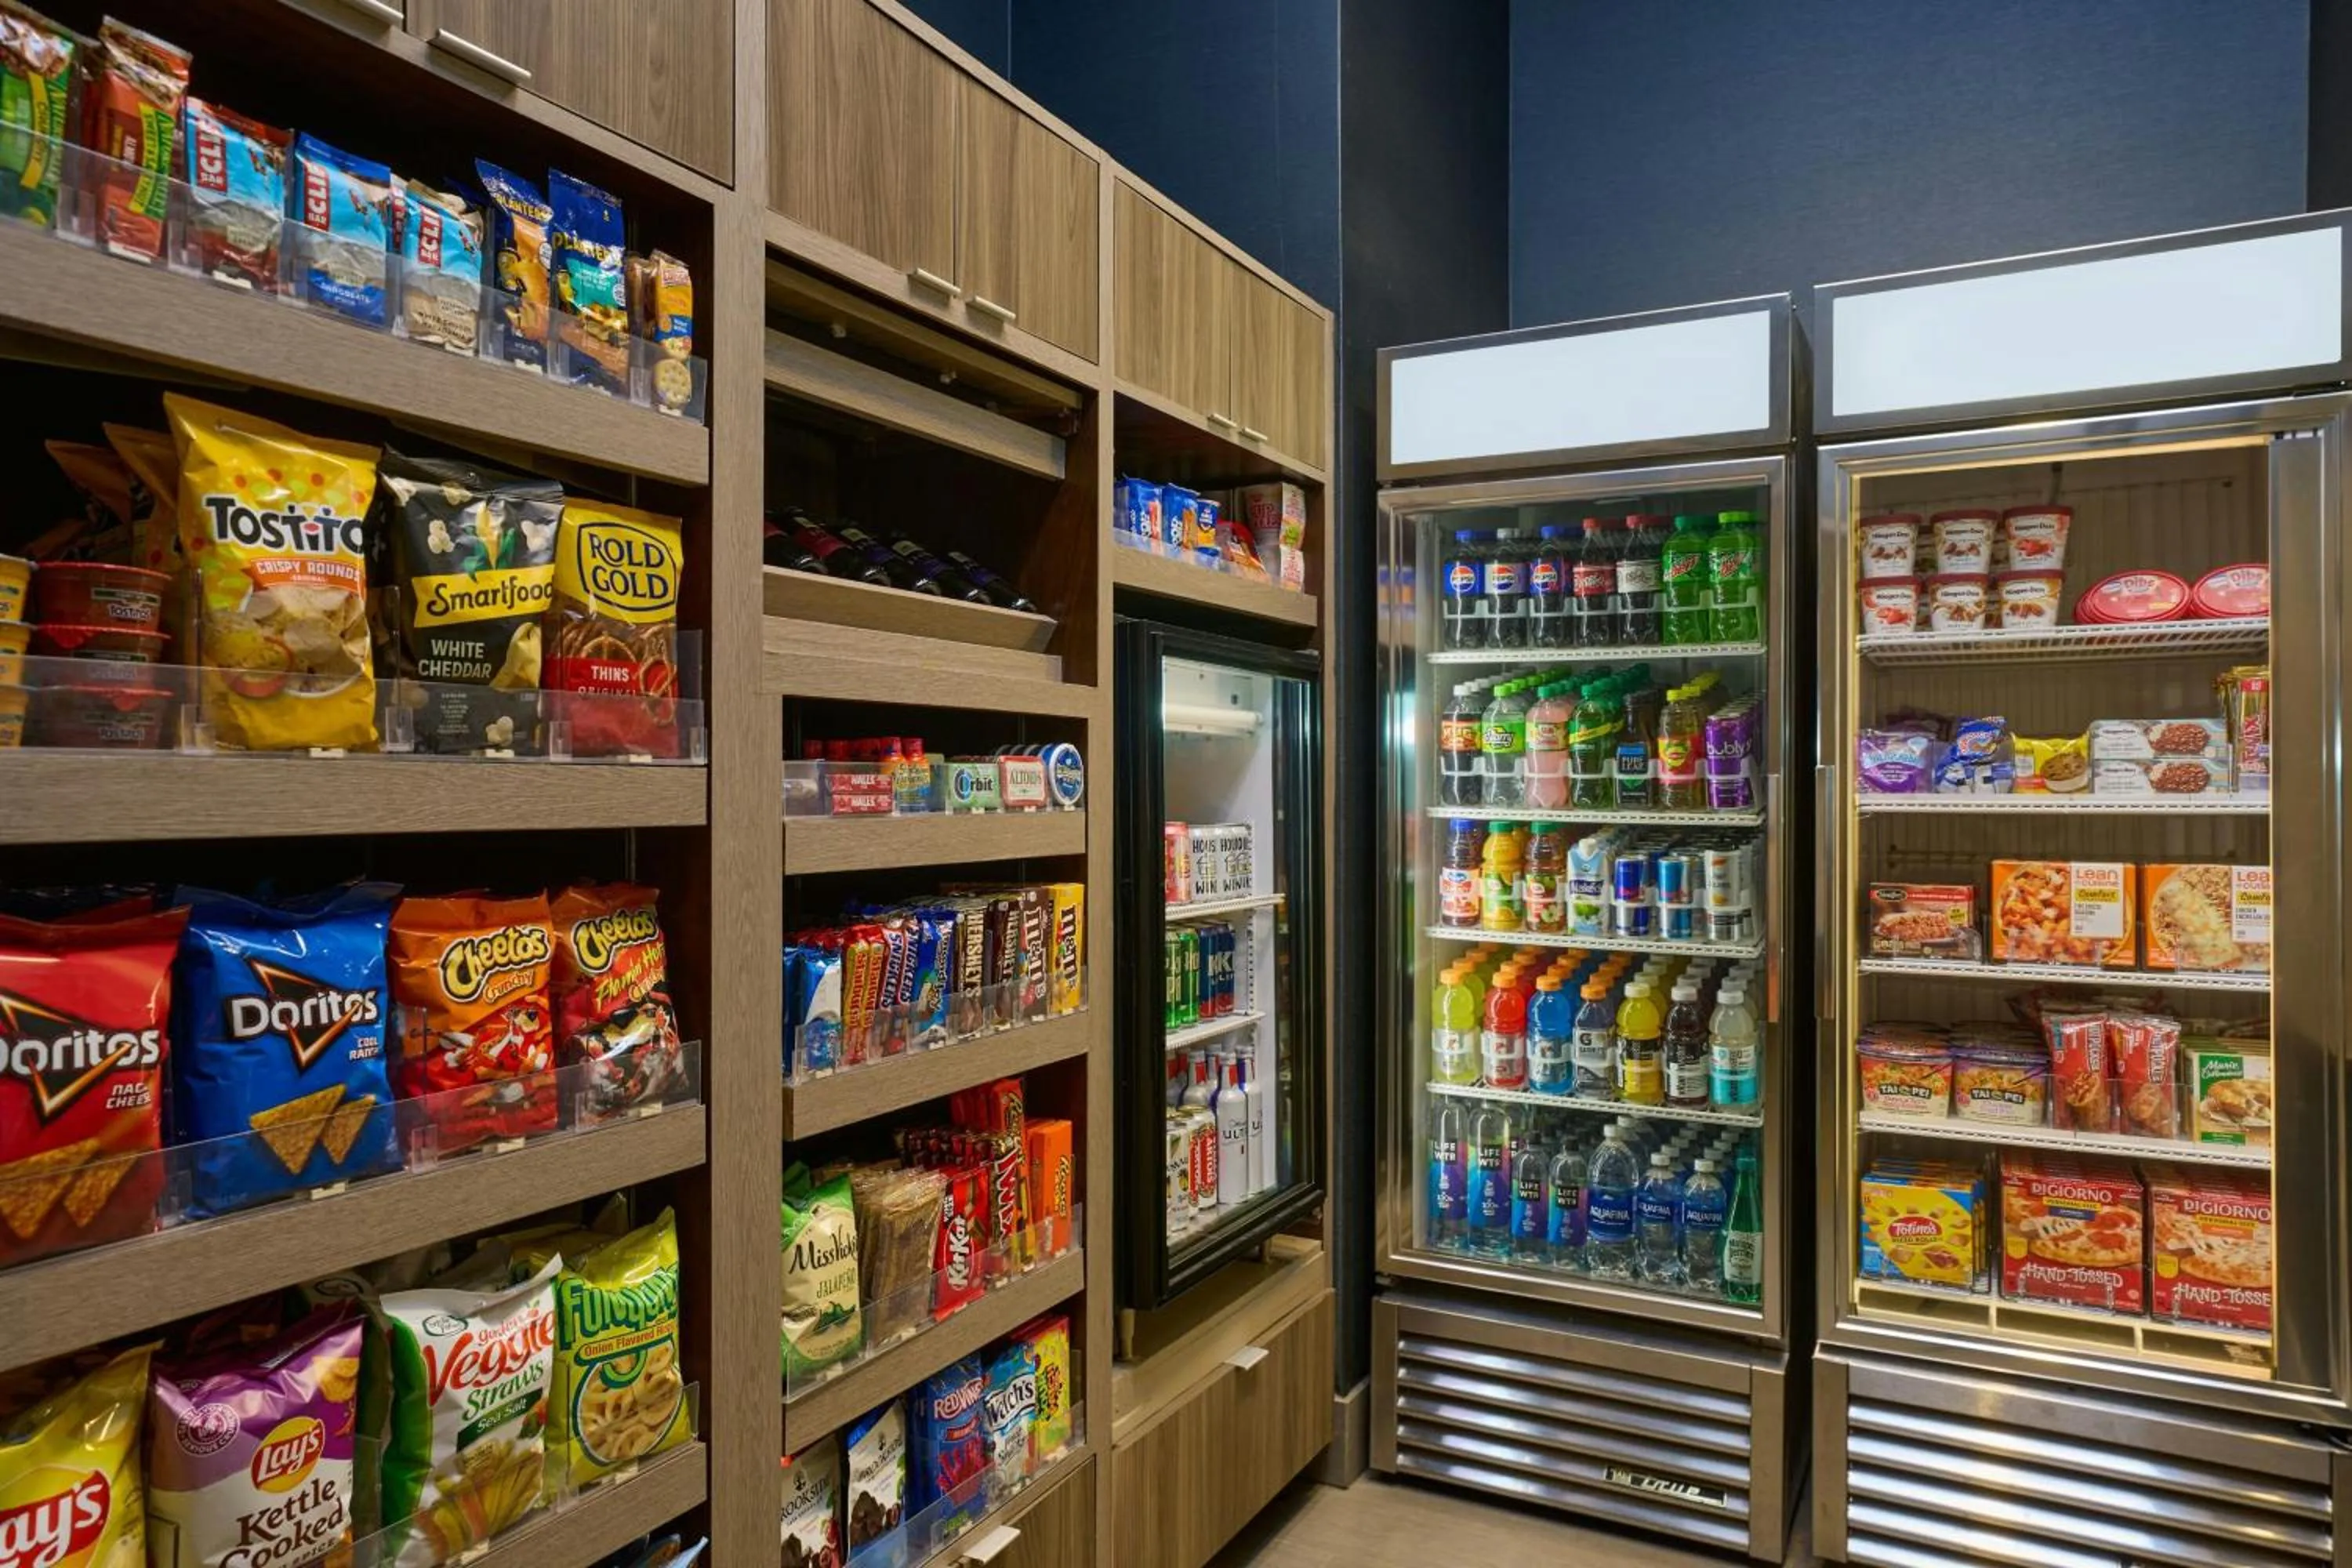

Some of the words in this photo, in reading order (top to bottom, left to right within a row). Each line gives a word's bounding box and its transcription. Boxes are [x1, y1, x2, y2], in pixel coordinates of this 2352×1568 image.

[205, 496, 365, 555] TOSTITO
[256, 561, 301, 574] CRISPY
[589, 533, 665, 568] ROLD
[591, 565, 669, 600] GOLD
[431, 639, 485, 659] WHITE
[418, 659, 492, 679] CHEDDAR
[590, 665, 630, 682] THINS
[953, 768, 994, 802] Orbit
[2076, 868, 2119, 880] Lean
[2237, 871, 2271, 883] Lea
[2239, 892, 2271, 902] Comfo
[574, 910, 659, 972] Cheetos
[440, 925, 550, 1002] Cheetos
[880, 932, 902, 1009] SNICKERS
[483, 968, 535, 1004] Crunchy
[231, 989, 378, 1039] Doritos
[1579, 1033, 1592, 1047] G
[1881, 1085, 1898, 1094] TAI
[1912, 1088, 1929, 1098] PEI
[1973, 1090, 1990, 1099] TAI
[2031, 1182, 2113, 1203] DIGIORNO
[1589, 1204, 1630, 1221] AQUAFINA
[2183, 1199, 2271, 1221] DIGIORNO
[788, 1240, 835, 1275] Miss
[2174, 1282, 2271, 1307] HAND-TOSSE
[422, 1309, 555, 1407] Veggie
[584, 1343, 614, 1356] Onion
[615, 1329, 655, 1348] Flavored
[462, 1359, 544, 1421] Straws
[477, 1412, 502, 1433] Sea
[504, 1397, 528, 1418] Salt
[257, 1426, 321, 1483] Lay's
[0, 1480, 103, 1568] ay's
[236, 1477, 337, 1548] Kettle
[219, 1498, 344, 1568] Cooked
